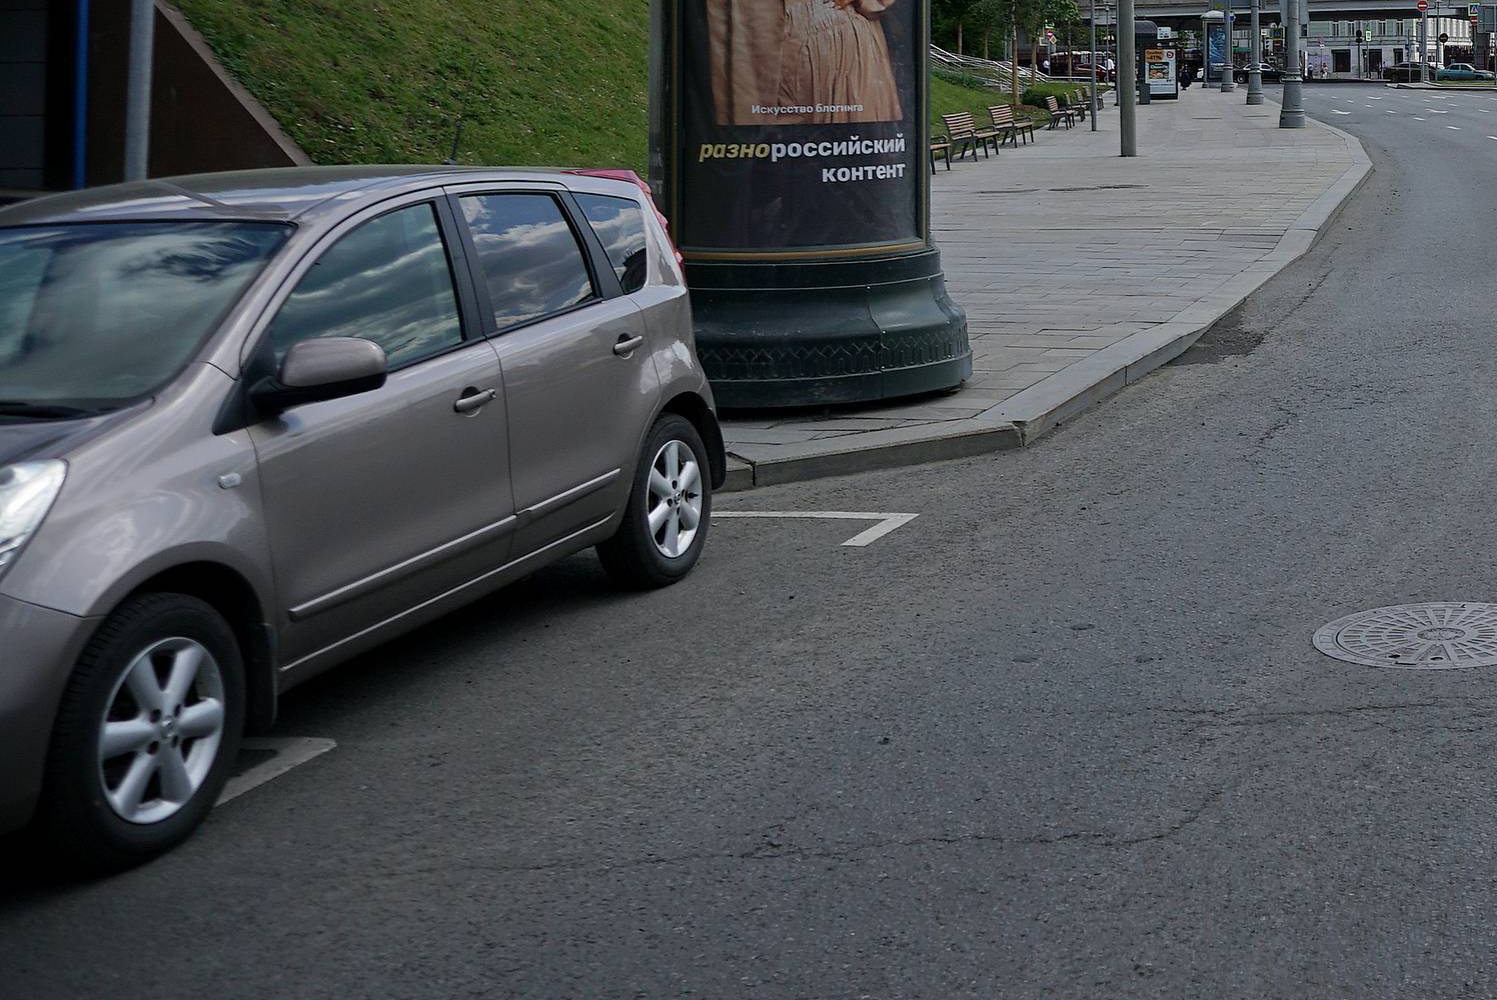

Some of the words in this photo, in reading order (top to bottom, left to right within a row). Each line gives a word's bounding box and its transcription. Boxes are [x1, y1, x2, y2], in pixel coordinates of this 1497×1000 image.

[751, 104, 814, 119] Искусство
[815, 103, 864, 114] блогинга
[699, 133, 906, 162] разнороссийский
[822, 163, 906, 183] контент
